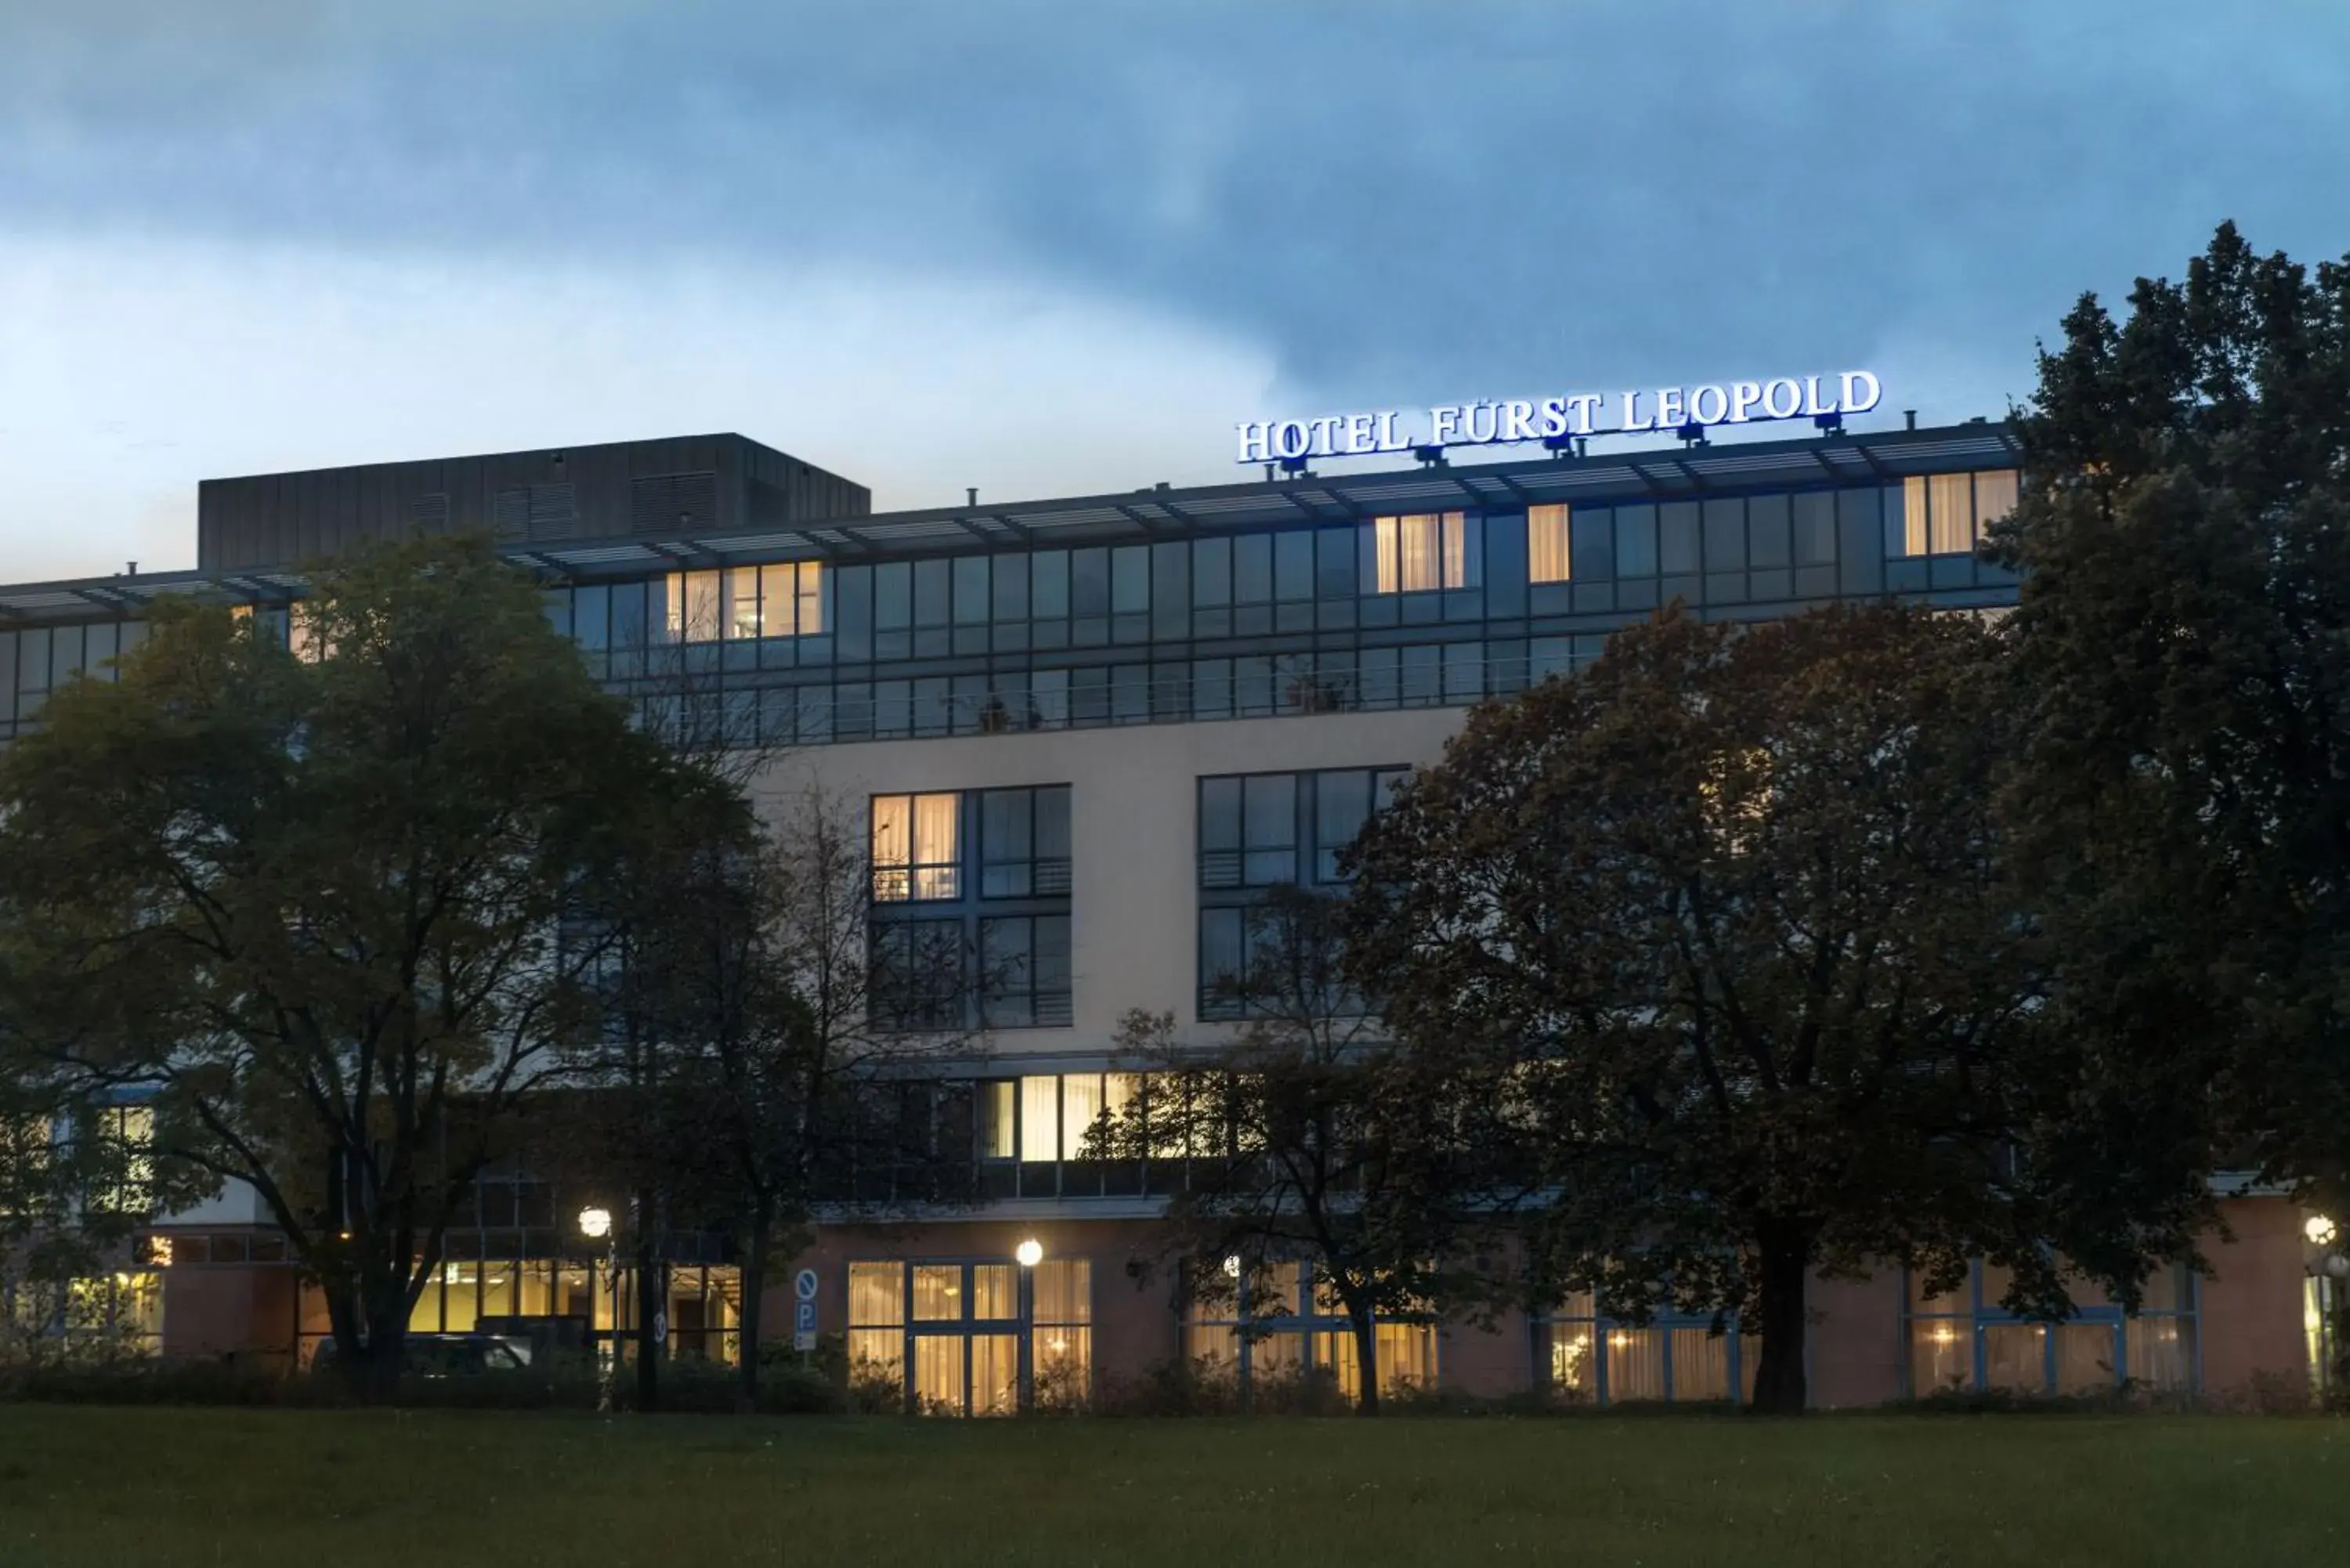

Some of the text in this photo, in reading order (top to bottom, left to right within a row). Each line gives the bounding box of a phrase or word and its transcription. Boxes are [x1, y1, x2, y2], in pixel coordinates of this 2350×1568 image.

[1236, 370, 1882, 463] HOTEL FÜRST LEOPOLD
[800, 1304, 812, 1330] P
